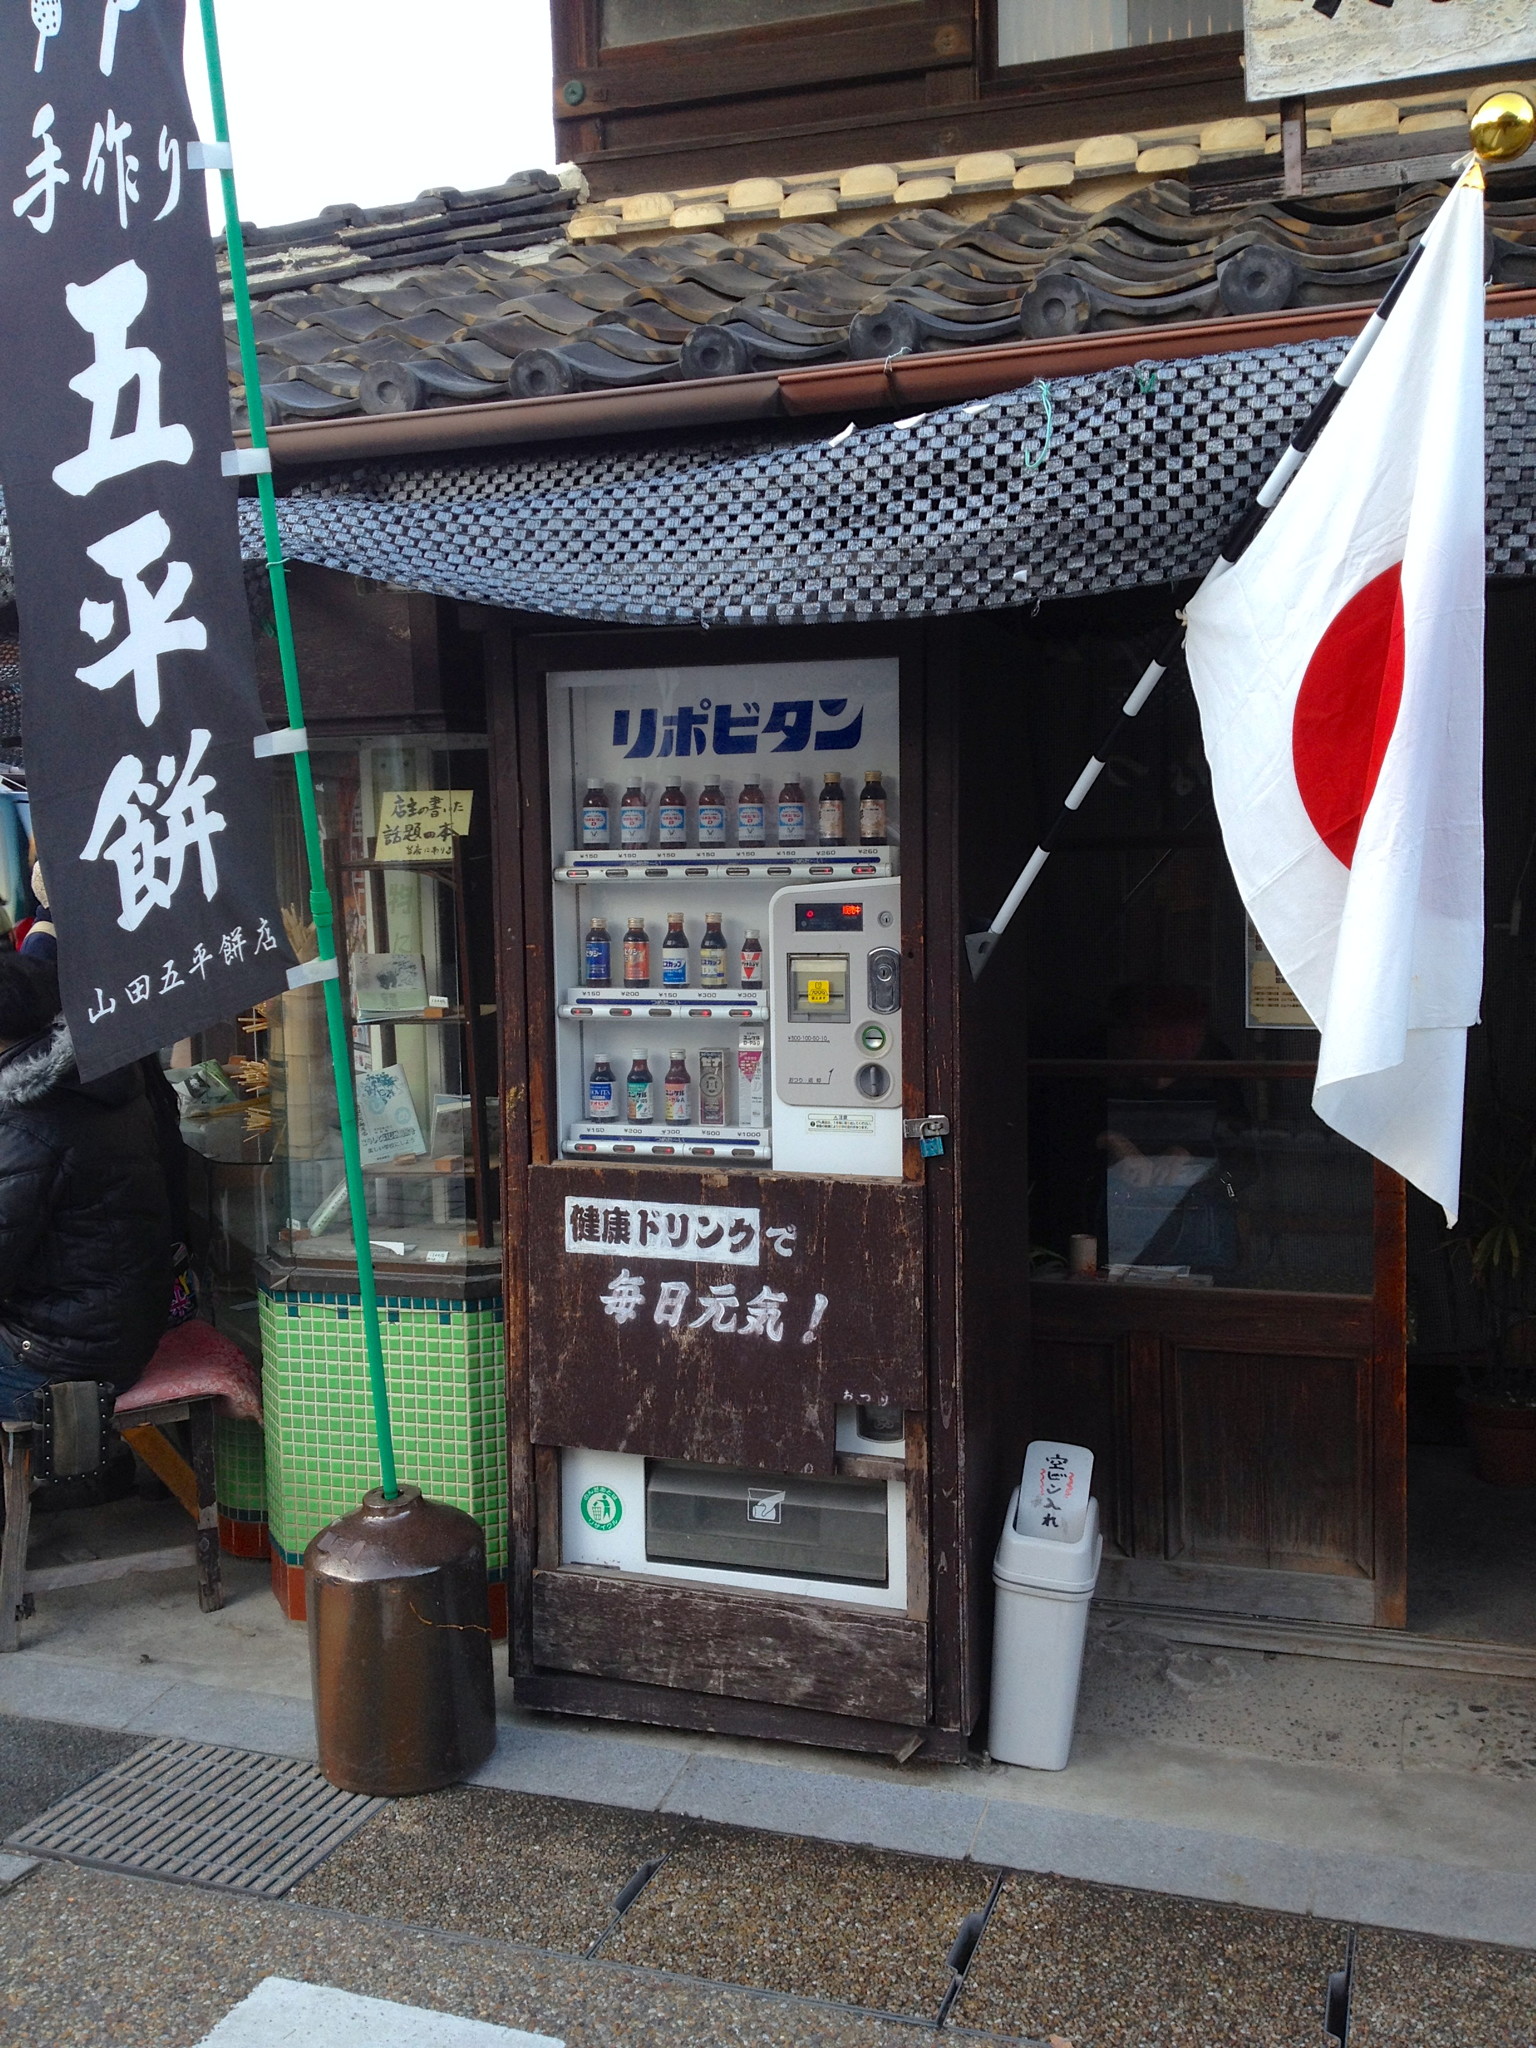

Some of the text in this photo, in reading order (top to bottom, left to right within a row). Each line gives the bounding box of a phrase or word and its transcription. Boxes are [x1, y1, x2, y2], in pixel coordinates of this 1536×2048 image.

[13, 103, 181, 234] 手作り
[52, 259, 227, 932] 五平餅
[612, 697, 864, 759] リポビタン
[382, 822, 460, 846] 話題の本
[391, 795, 464, 818] 店主の書いた
[88, 918, 278, 1024] 山田五平餅店
[843, 1389, 890, 1407] おつり
[1041, 1453, 1068, 1528] 空ビン入れ
